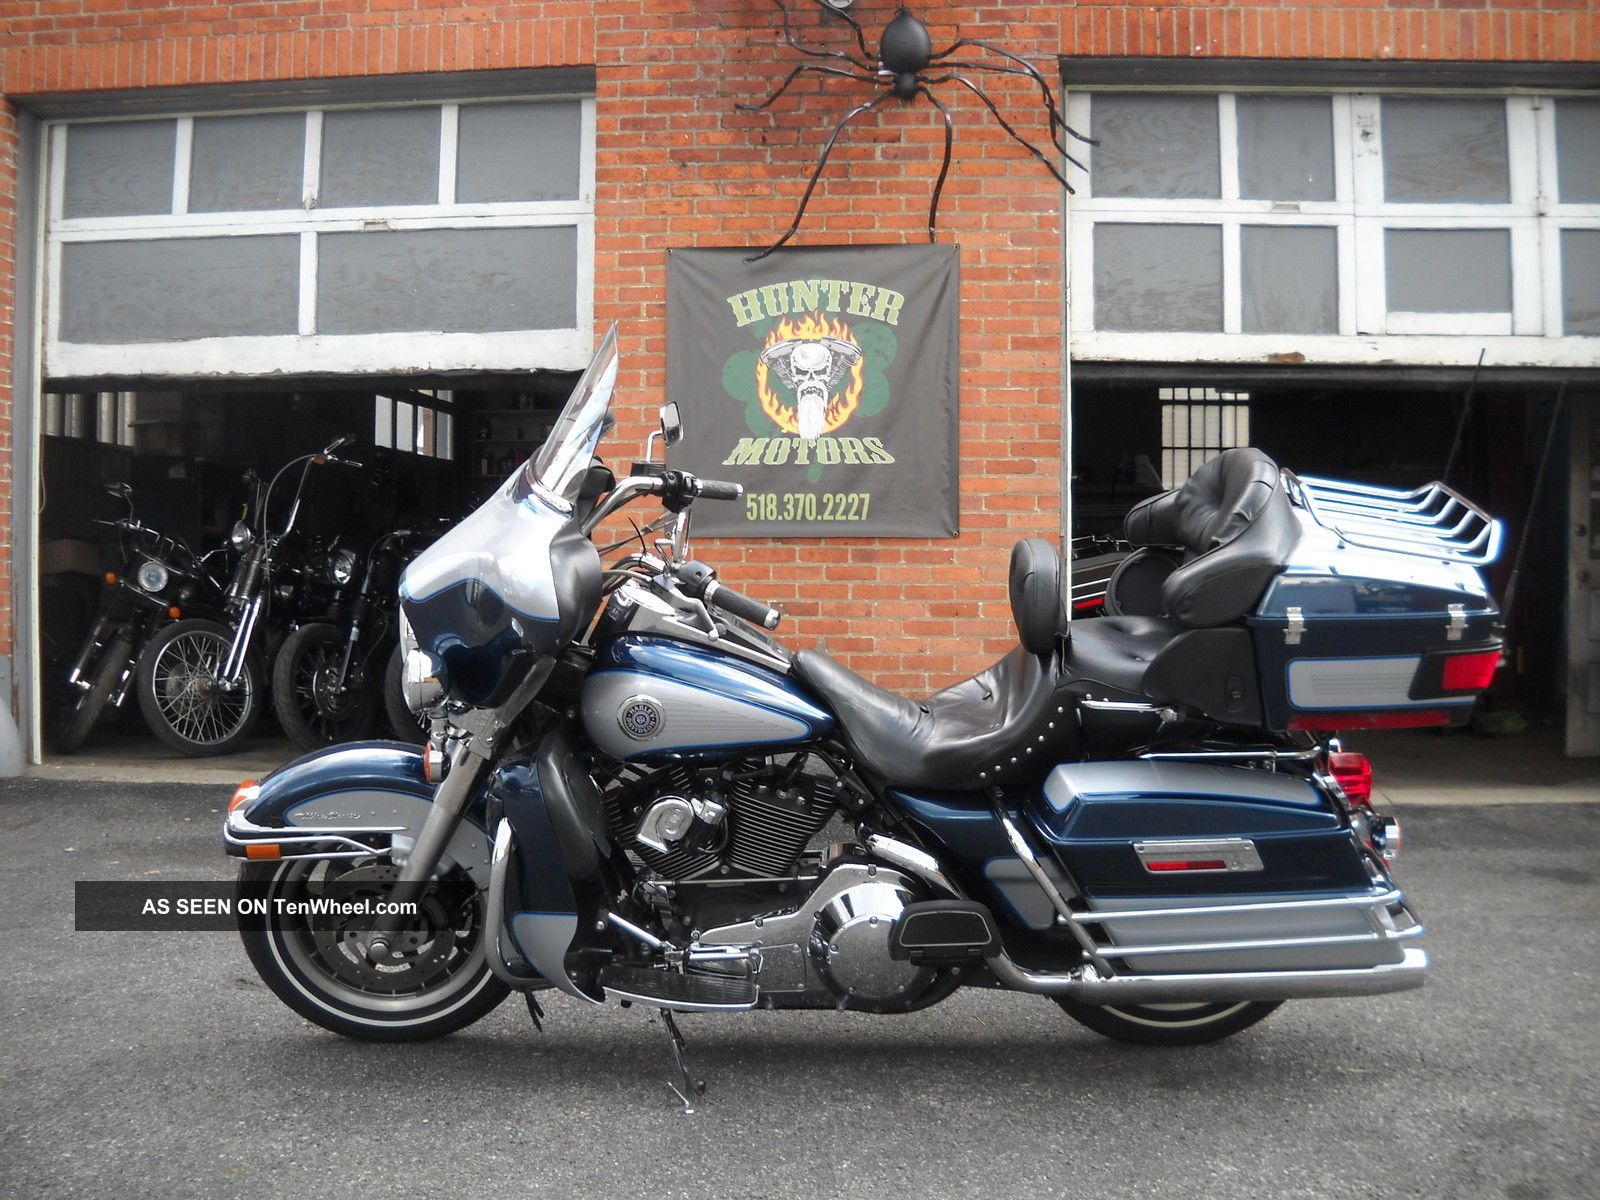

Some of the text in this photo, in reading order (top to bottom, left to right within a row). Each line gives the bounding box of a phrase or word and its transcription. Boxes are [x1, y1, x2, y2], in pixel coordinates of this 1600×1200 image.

[727, 279, 905, 327] HUNTER
[722, 437, 896, 466] MOTORS
[746, 493, 870, 521] 518.370.2227
